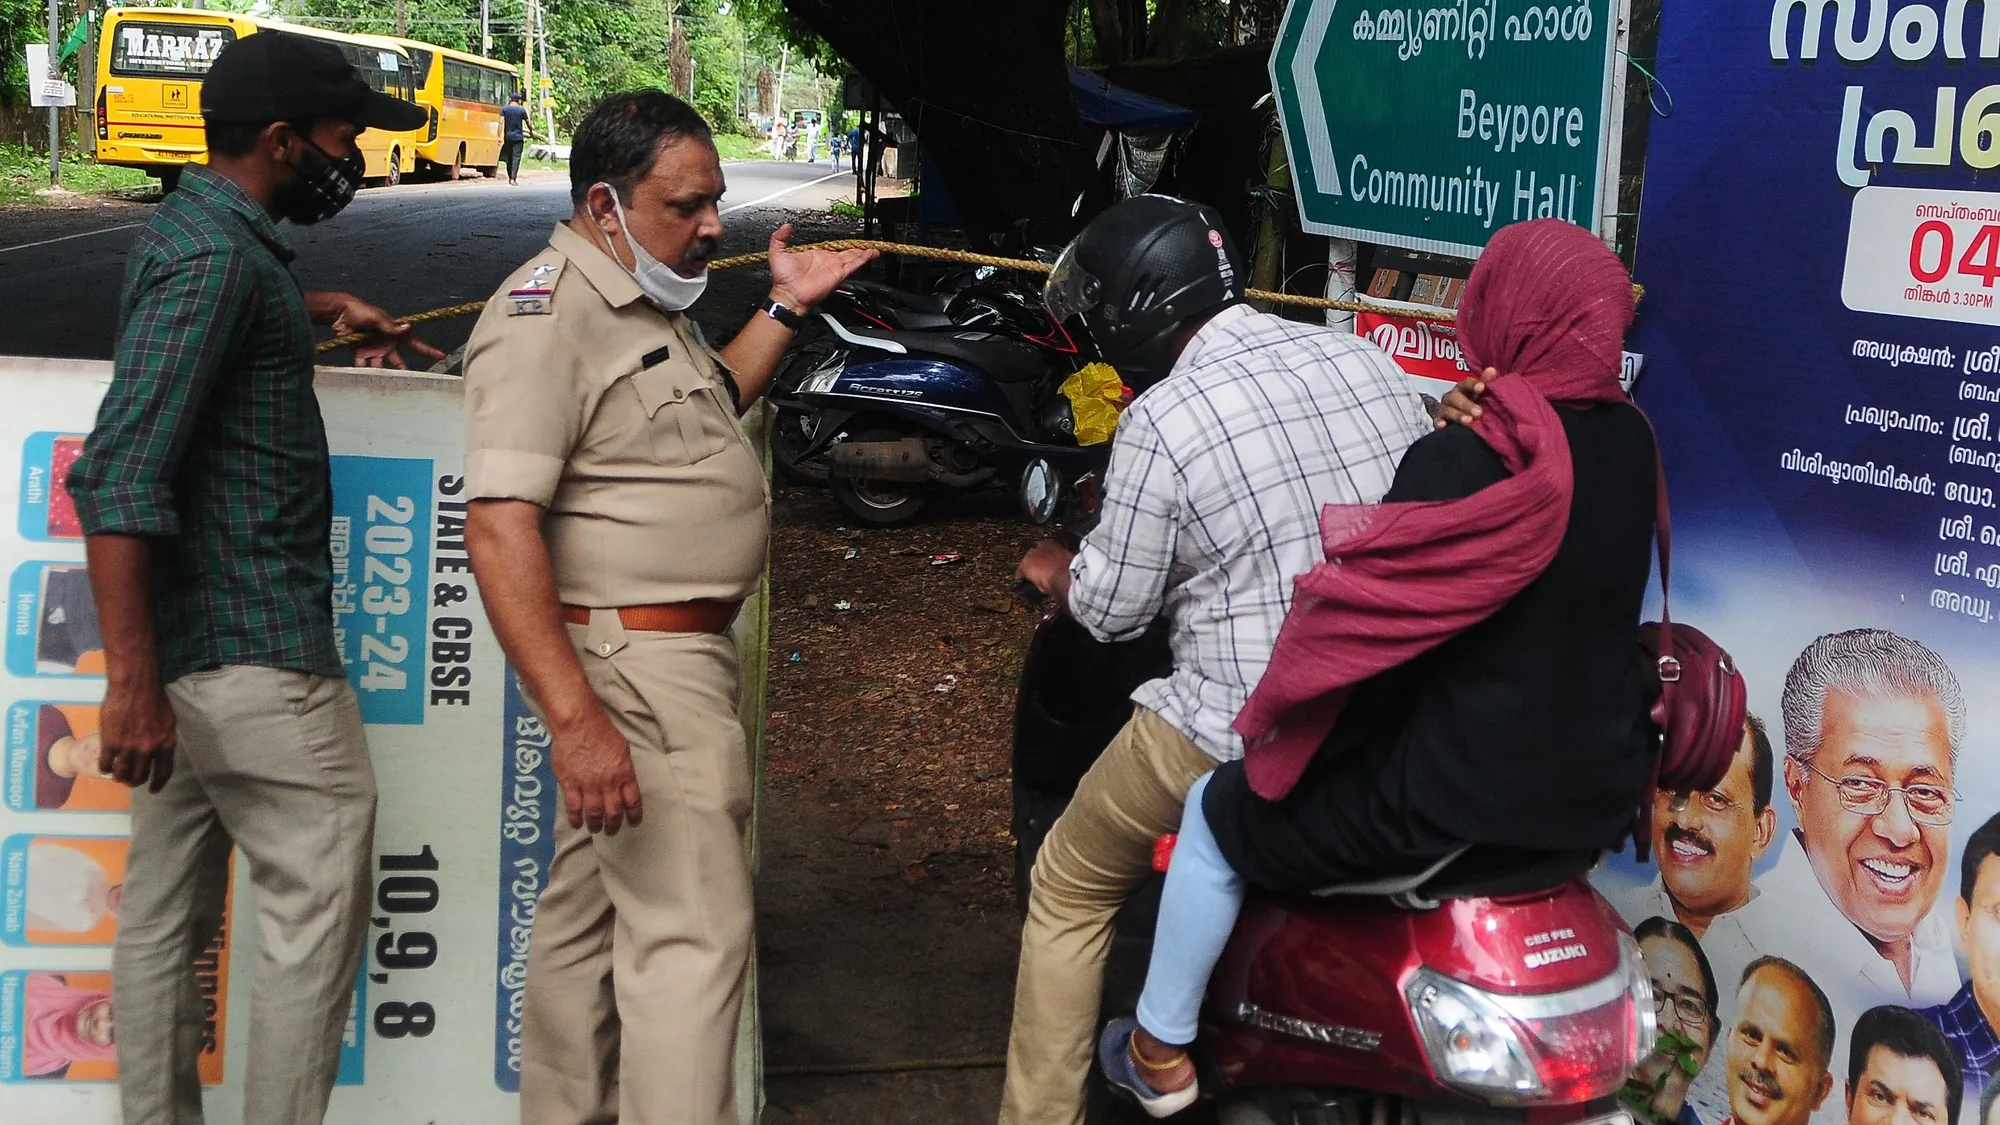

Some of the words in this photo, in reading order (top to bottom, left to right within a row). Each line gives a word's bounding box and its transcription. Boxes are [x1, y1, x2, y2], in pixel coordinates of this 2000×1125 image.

[1504, 2, 1593, 41] ഹാൾ
[123, 28, 223, 60] MARKAZ
[1458, 88, 1584, 152] Beypore
[1350, 153, 1500, 229] Community
[1513, 169, 1577, 225] Hall
[1908, 219, 2000, 288] 04
[1903, 284, 1951, 304] തിങ്കൾ
[1953, 291, 1994, 309] 3.30PM
[1952, 412, 1992, 441] ശ്രീ.
[25, 466, 45, 504] Arathi
[1944, 481, 1996, 508] ഡോ.
[436, 474, 473, 573] STATE
[1939, 514, 1975, 541] ശ്രീ.
[1934, 550, 1971, 577] ശ്രീ.
[360, 494, 415, 692] 2023-24
[434, 582, 469, 608] &
[1931, 588, 1993, 623] അഡ്വ.
[14, 594, 34, 636] Henna
[431, 617, 473, 706] CBSE
[9, 748, 29, 809] Mansoor
[1524, 932, 1550, 946] CEE
[1550, 928, 1575, 941] PEE
[1524, 943, 1587, 969] SUZUKI
[374, 1001, 436, 1040] 8
